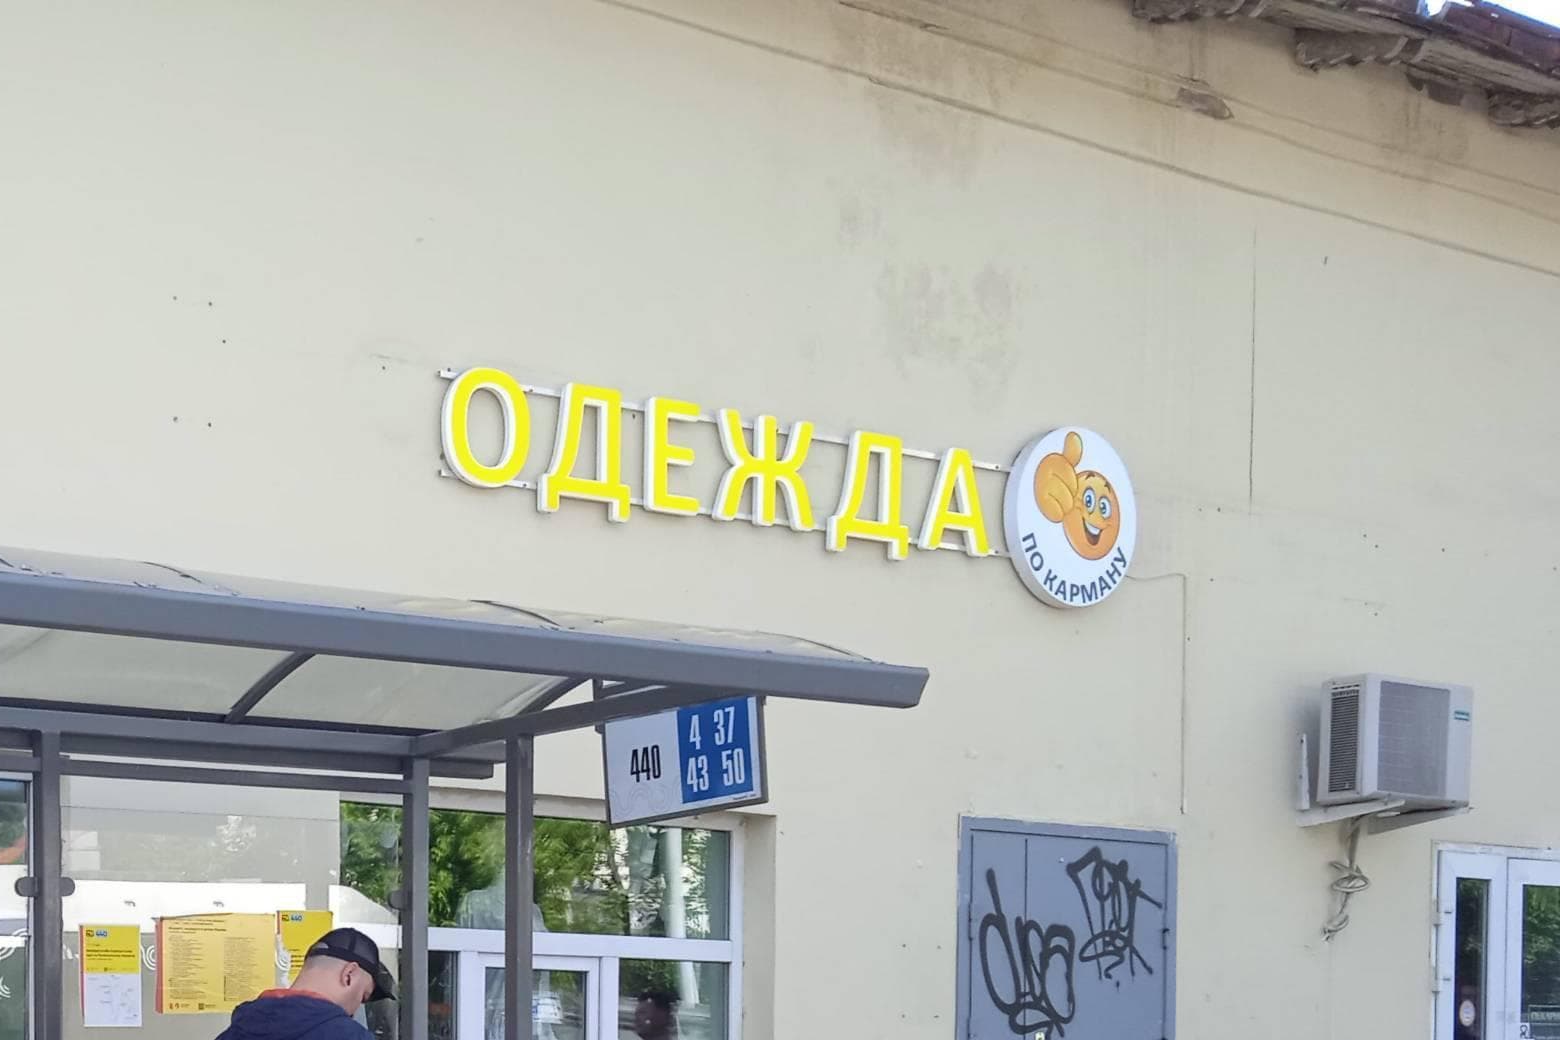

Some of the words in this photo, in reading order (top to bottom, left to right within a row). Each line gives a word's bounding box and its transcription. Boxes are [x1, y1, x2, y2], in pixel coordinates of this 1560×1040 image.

[442, 366, 990, 561] ОДЕЖДА
[1022, 532, 1044, 571] ПО
[1043, 546, 1127, 603] КАРМАНУ
[689, 714, 701, 749] 4
[713, 706, 735, 745] 37
[630, 745, 661, 783] 440
[686, 755, 709, 792] 43
[721, 748, 745, 786] 50
